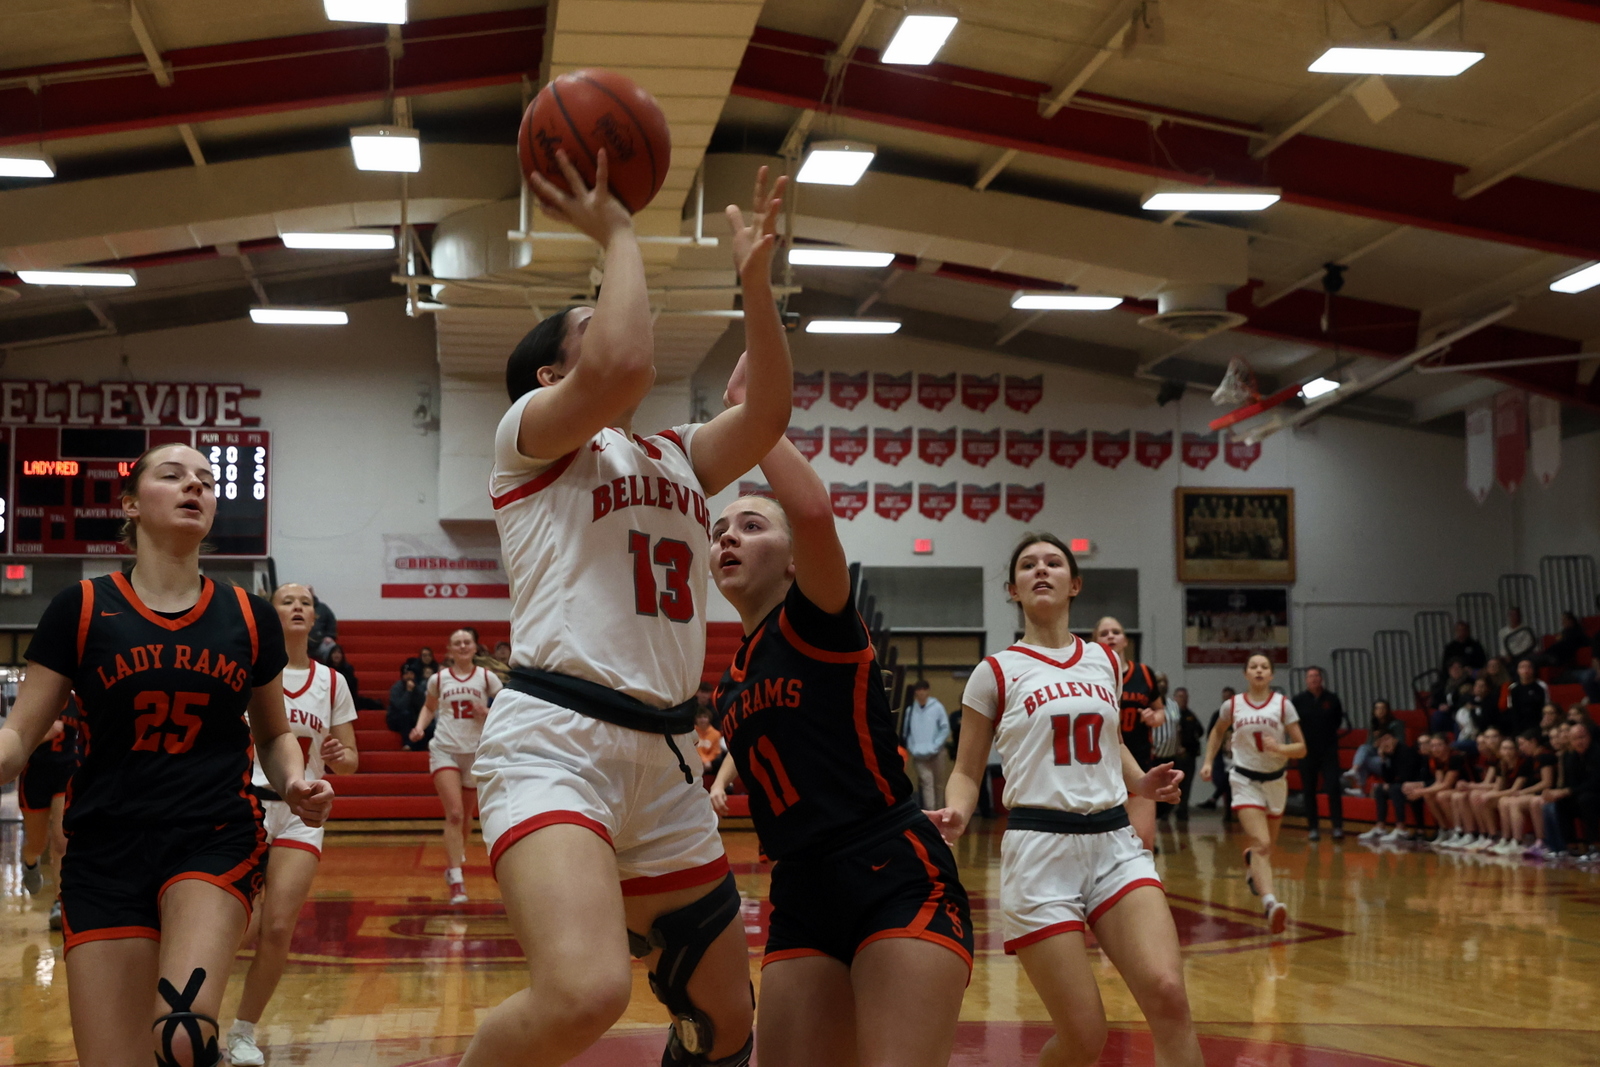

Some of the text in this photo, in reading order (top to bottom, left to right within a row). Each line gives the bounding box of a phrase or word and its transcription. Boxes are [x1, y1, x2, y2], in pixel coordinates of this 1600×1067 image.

[210, 445, 266, 464] 2 0 2
[23, 460, 79, 476] LADYRED
[87, 468, 119, 480] PERIOD
[226, 464, 238, 482] 0
[253, 464, 266, 482] 2
[225, 482, 238, 500] 0
[253, 482, 266, 500] 0
[16, 507, 128, 519] FOULS PLAYER FOU
[15, 543, 117, 554] SCORE MATCH
[628, 529, 694, 624] 13
[97, 644, 248, 693] LADY RAMS
[741, 677, 803, 720] RAMS
[451, 700, 474, 719] 12
[131, 690, 211, 755] 25
[1050, 712, 1104, 767] 10
[1253, 731, 1264, 752] 1
[748, 734, 802, 817] 11
